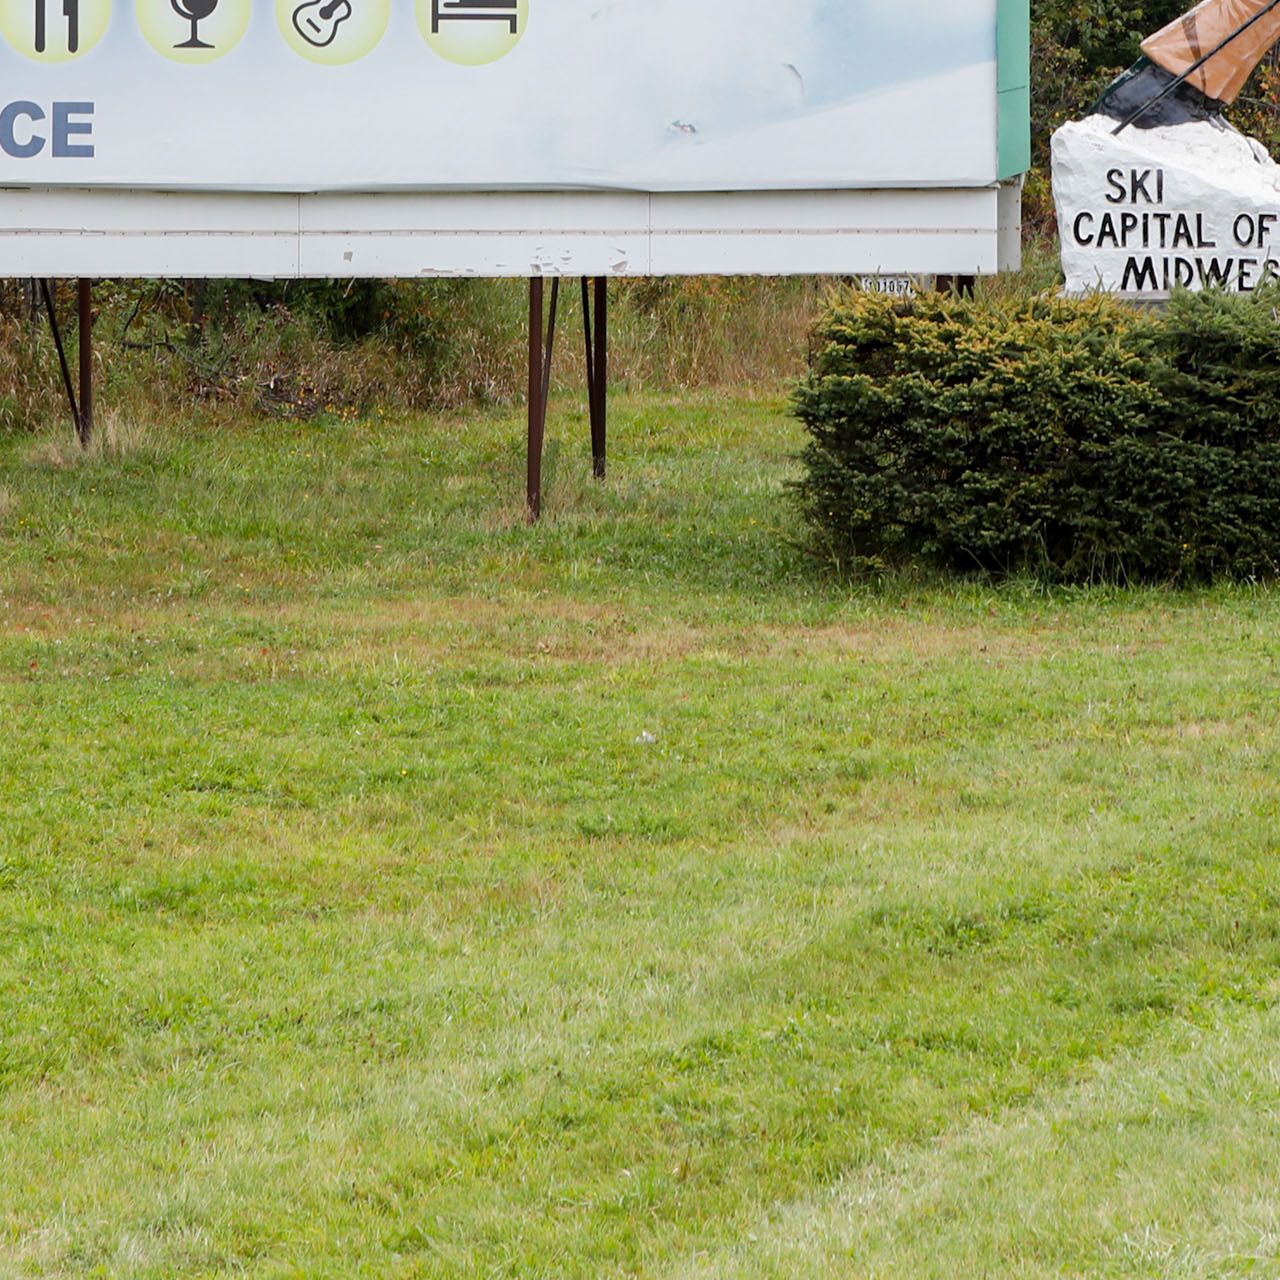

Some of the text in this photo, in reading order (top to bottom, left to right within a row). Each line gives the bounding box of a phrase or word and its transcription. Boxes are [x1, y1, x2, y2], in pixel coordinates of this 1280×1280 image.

[1105, 168, 1164, 204] SKI
[1073, 212, 1216, 248] CAPITAL
[1233, 213, 1278, 248] OF
